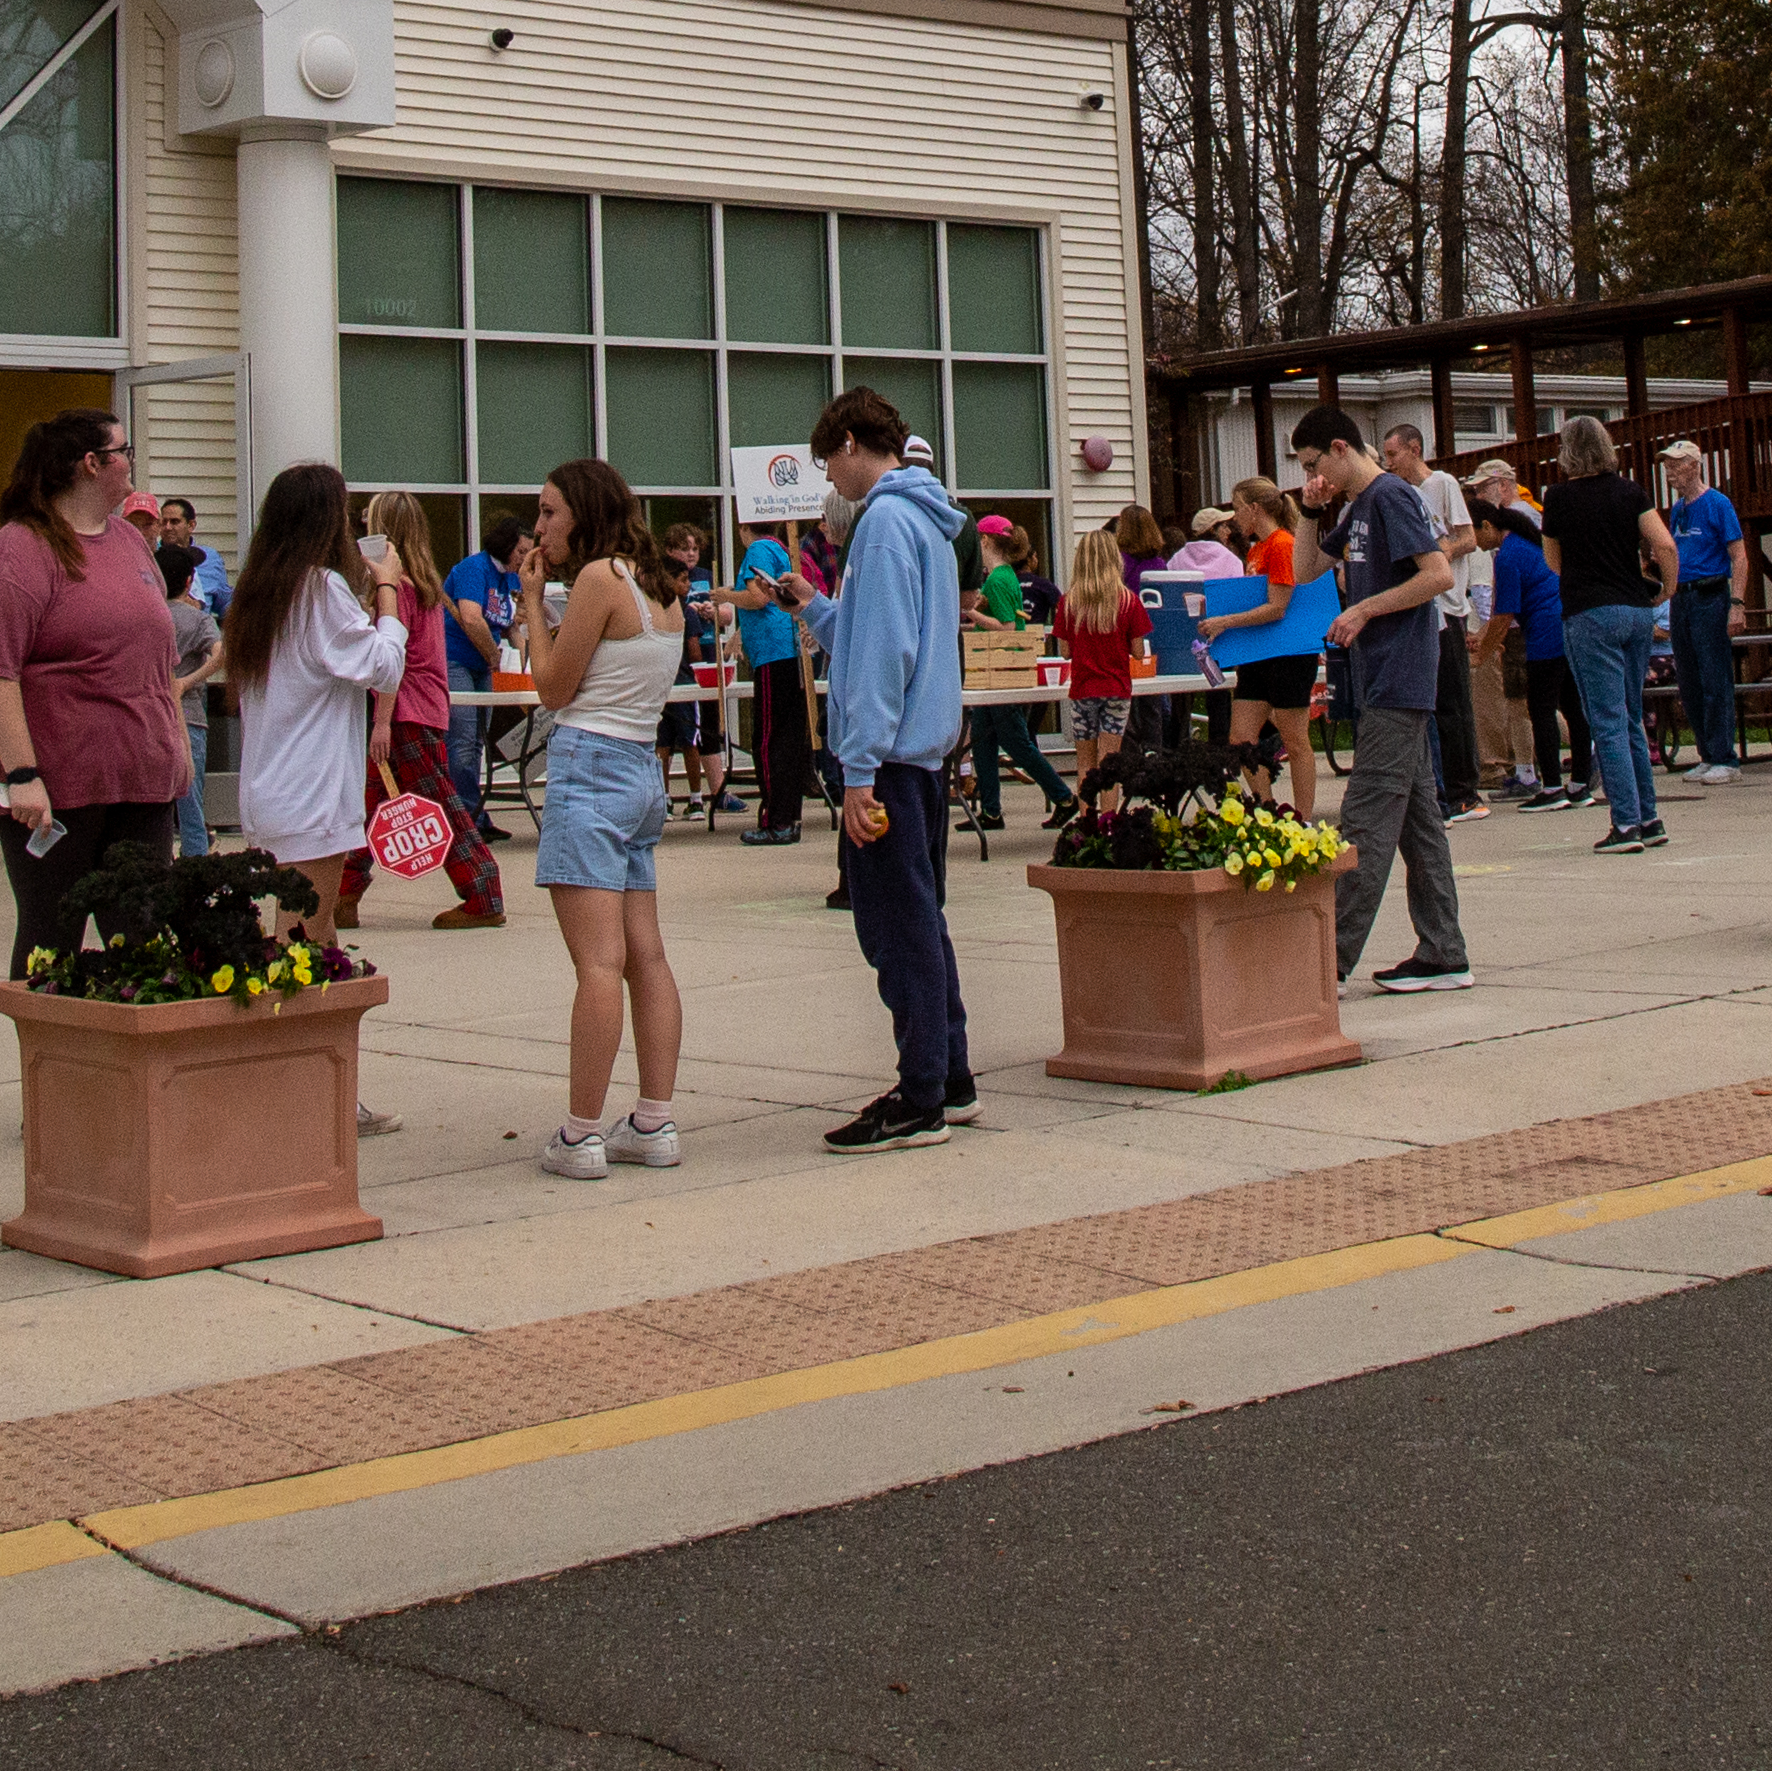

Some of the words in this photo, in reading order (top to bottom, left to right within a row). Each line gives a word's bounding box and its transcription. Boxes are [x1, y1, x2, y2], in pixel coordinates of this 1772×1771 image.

[753, 495, 789, 505] Walking
[792, 495, 800, 503] in
[755, 507, 786, 515] Abiding
[380, 798, 417, 820] HUNGER
[391, 811, 414, 828] STOP
[383, 817, 443, 863] CROP
[410, 853, 434, 871] HELP
